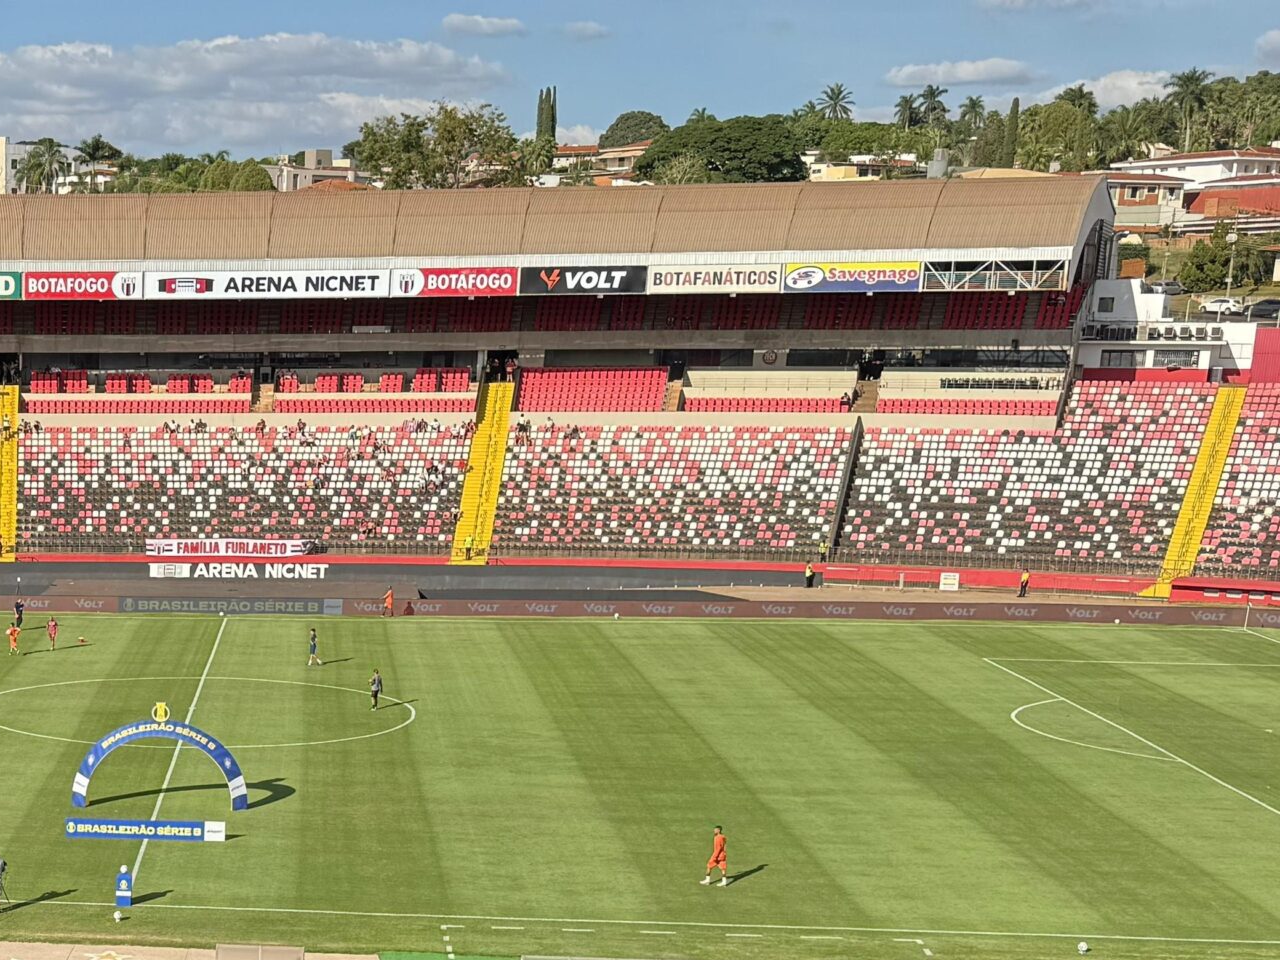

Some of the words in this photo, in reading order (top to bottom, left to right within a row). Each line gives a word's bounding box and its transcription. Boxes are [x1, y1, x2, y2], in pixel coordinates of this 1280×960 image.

[565, 270, 628, 289] VOLT
[652, 267, 778, 287] BOTAFANÁTICOS
[826, 264, 918, 285] Savegnago
[27, 277, 109, 294] BOTAFOGO
[224, 275, 298, 293] ARENA
[305, 275, 380, 292] NICNET
[427, 272, 513, 290] BOTAFOGO
[176, 539, 220, 554] FAMÍLIA
[225, 540, 287, 555] FURLANETO
[194, 563, 258, 578] ARENA
[265, 563, 329, 579] NICNET
[75, 598, 104, 608] VOLT
[138, 599, 249, 612] BRASILEIRÃO
[254, 598, 303, 612] SÉRIE
[308, 602, 318, 612] B
[412, 602, 442, 612] VOLT
[468, 603, 500, 613] VOLT
[525, 603, 558, 613] VOLT
[584, 603, 616, 613] VOLT
[642, 604, 674, 614] VOLT
[701, 604, 736, 614] VOLT
[762, 605, 796, 615] VOLT
[822, 605, 856, 615] VOLT
[882, 605, 916, 616] VOLT
[943, 606, 977, 616] VOLT
[1004, 606, 1038, 617] VOLT
[1066, 608, 1100, 618] VOLT
[1128, 609, 1162, 620] VOLT
[1191, 611, 1226, 621] VOLT
[101, 722, 174, 749] BRASILEIRÃO
[175, 726, 208, 745] SÉRIE
[76, 823, 155, 835] BRASILEIRÃO
[156, 825, 192, 836] SÉRIE
[193, 828, 202, 836] B
